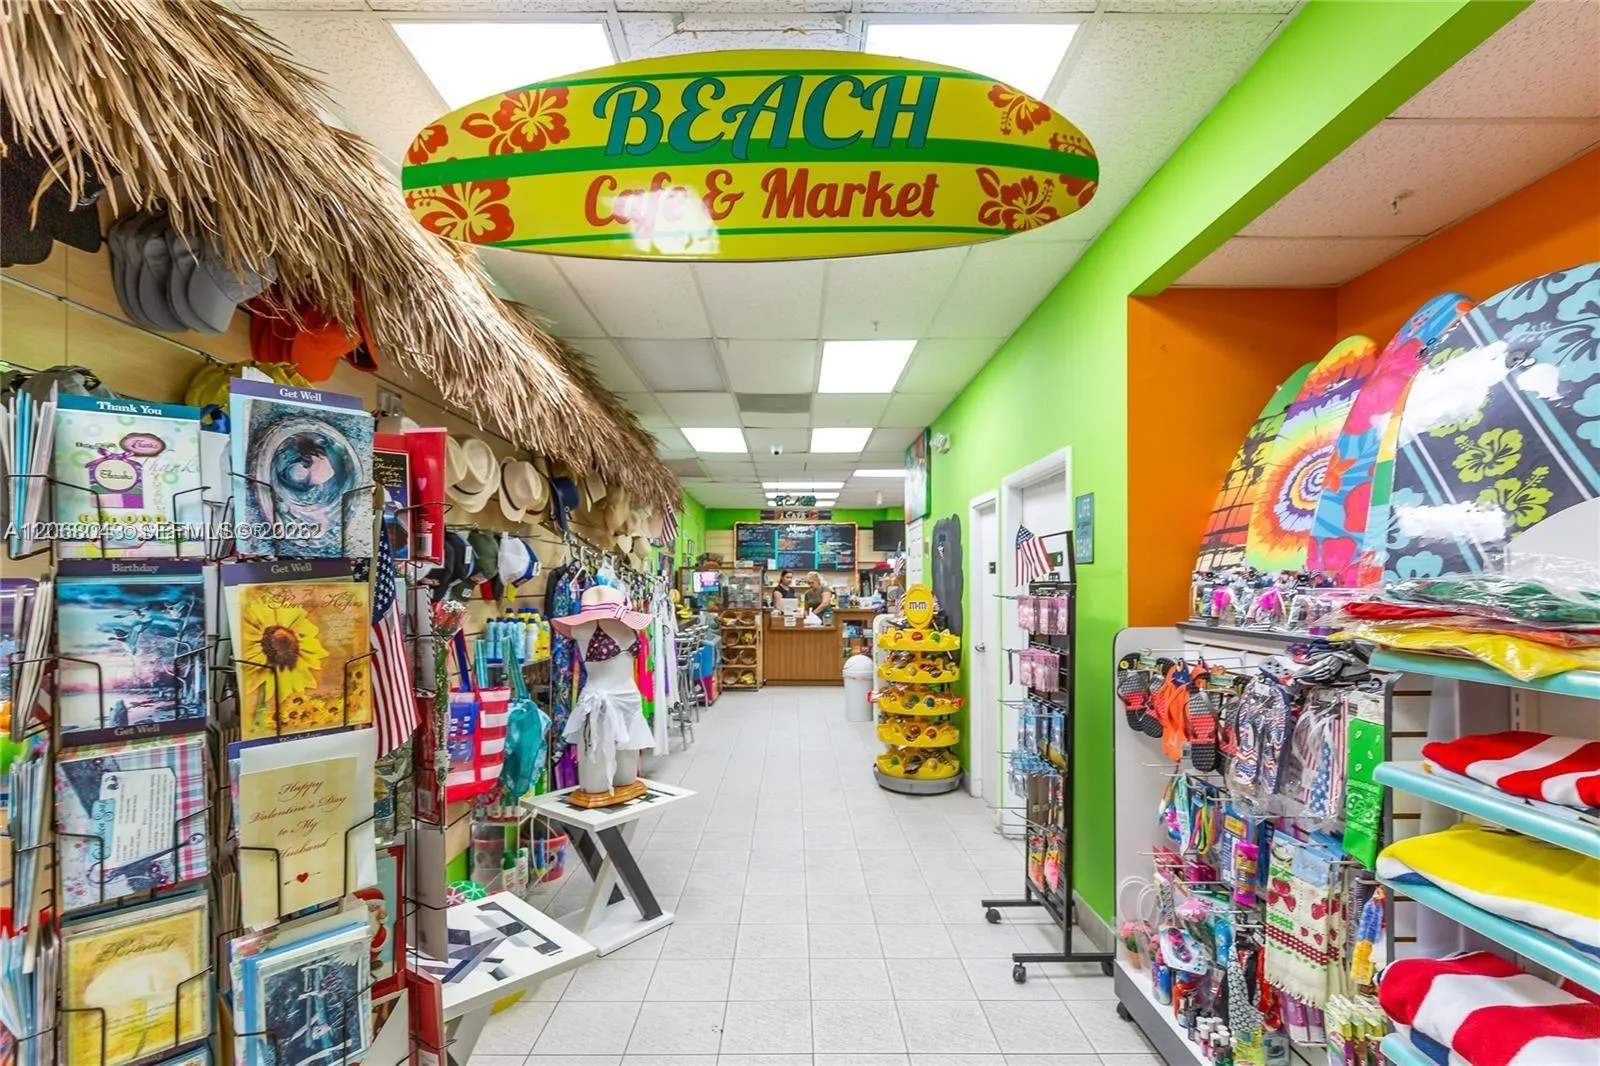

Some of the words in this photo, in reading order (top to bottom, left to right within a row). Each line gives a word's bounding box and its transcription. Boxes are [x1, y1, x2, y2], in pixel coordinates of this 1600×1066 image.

[592, 74, 940, 159] BEACH
[584, 172, 687, 240] Cafe
[704, 168, 744, 221] &
[761, 166, 941, 221] Market
[279, 388, 298, 399] Get
[299, 390, 322, 402] Well
[96, 401, 138, 413] Thank
[139, 405, 162, 416] You
[111, 563, 160, 574] Birthday
[270, 564, 290, 574] Get
[290, 561, 312, 572] Well
[114, 727, 135, 736] Get
[136, 723, 160, 733] Well
[277, 780, 324, 802] Happy
[248, 801, 316, 824] Valentine's
[318, 793, 348, 814] Day
[277, 825, 290, 837] to
[290, 818, 320, 837] My
[270, 832, 338, 862] Husband
